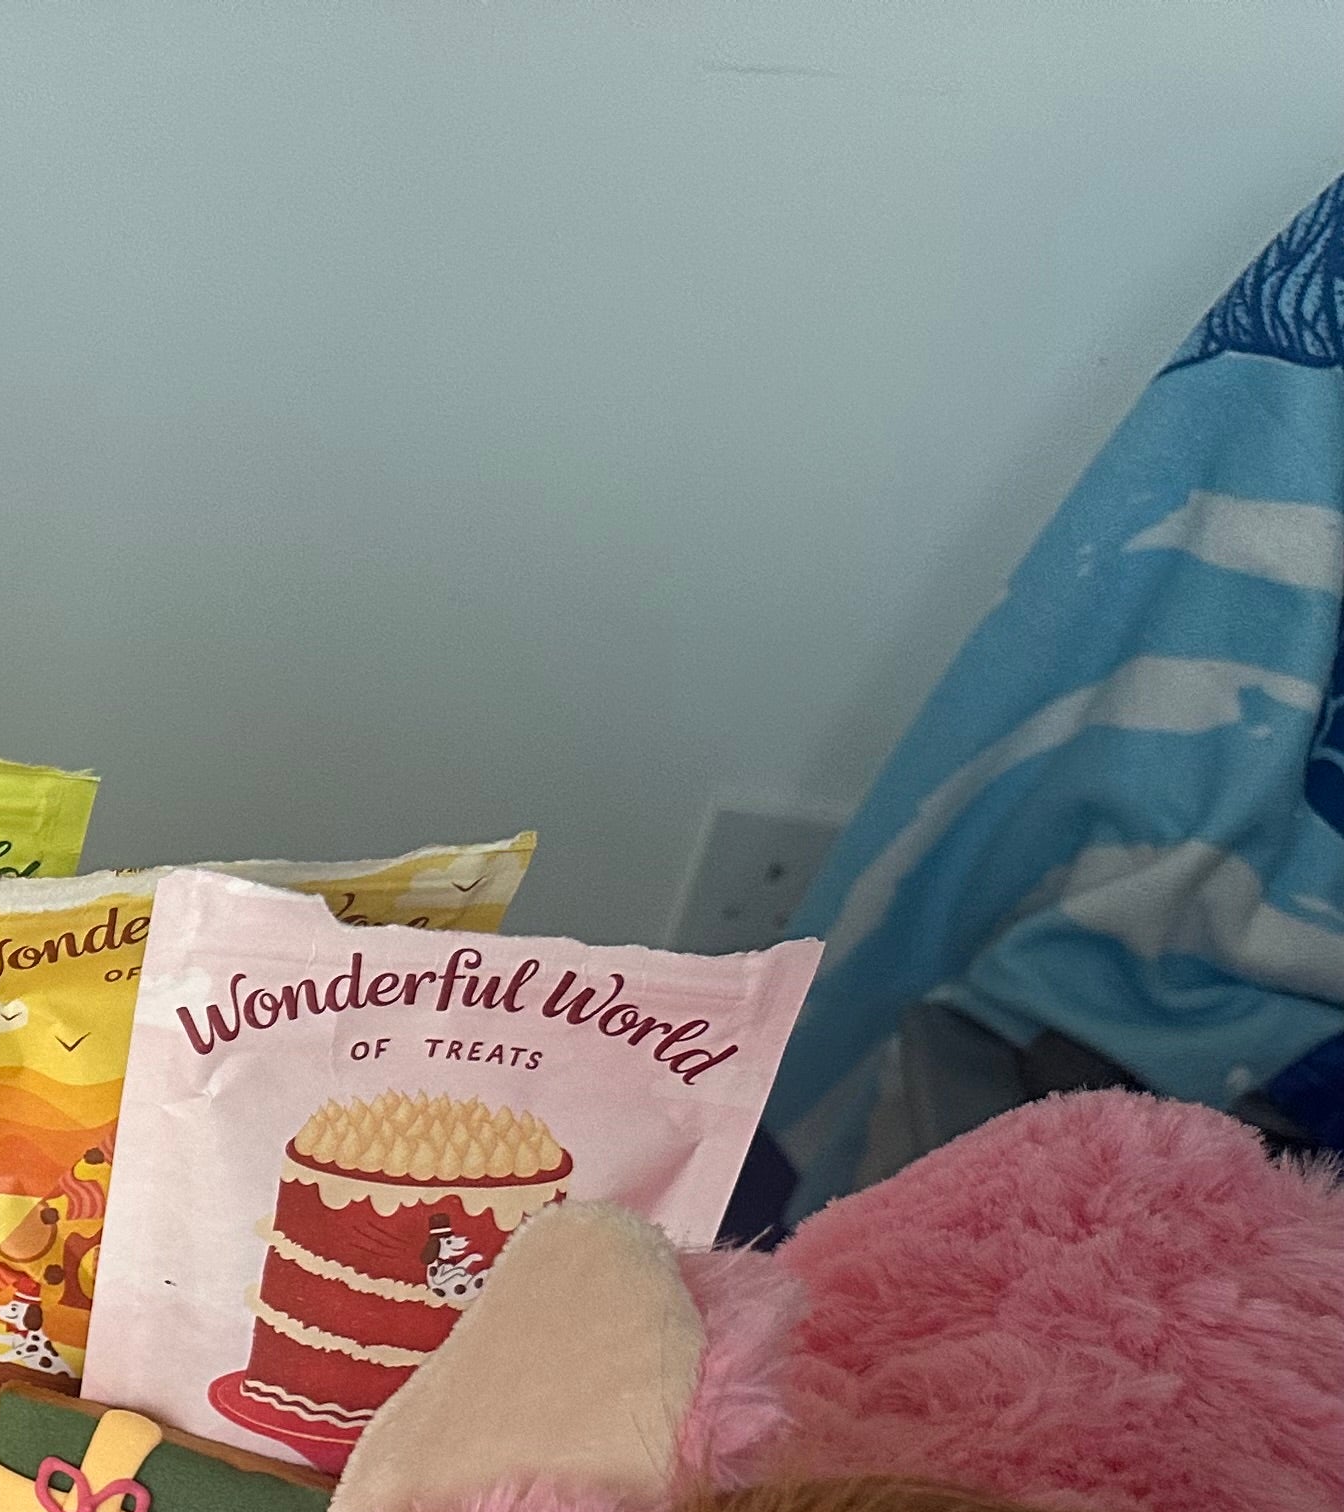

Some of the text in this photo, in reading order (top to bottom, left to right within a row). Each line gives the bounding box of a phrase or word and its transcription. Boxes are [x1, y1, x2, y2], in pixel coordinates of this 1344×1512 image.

[104, 966, 141, 982] OF
[176, 948, 739, 1085] Wonderful World
[350, 1038, 543, 1070] OF TREATS
